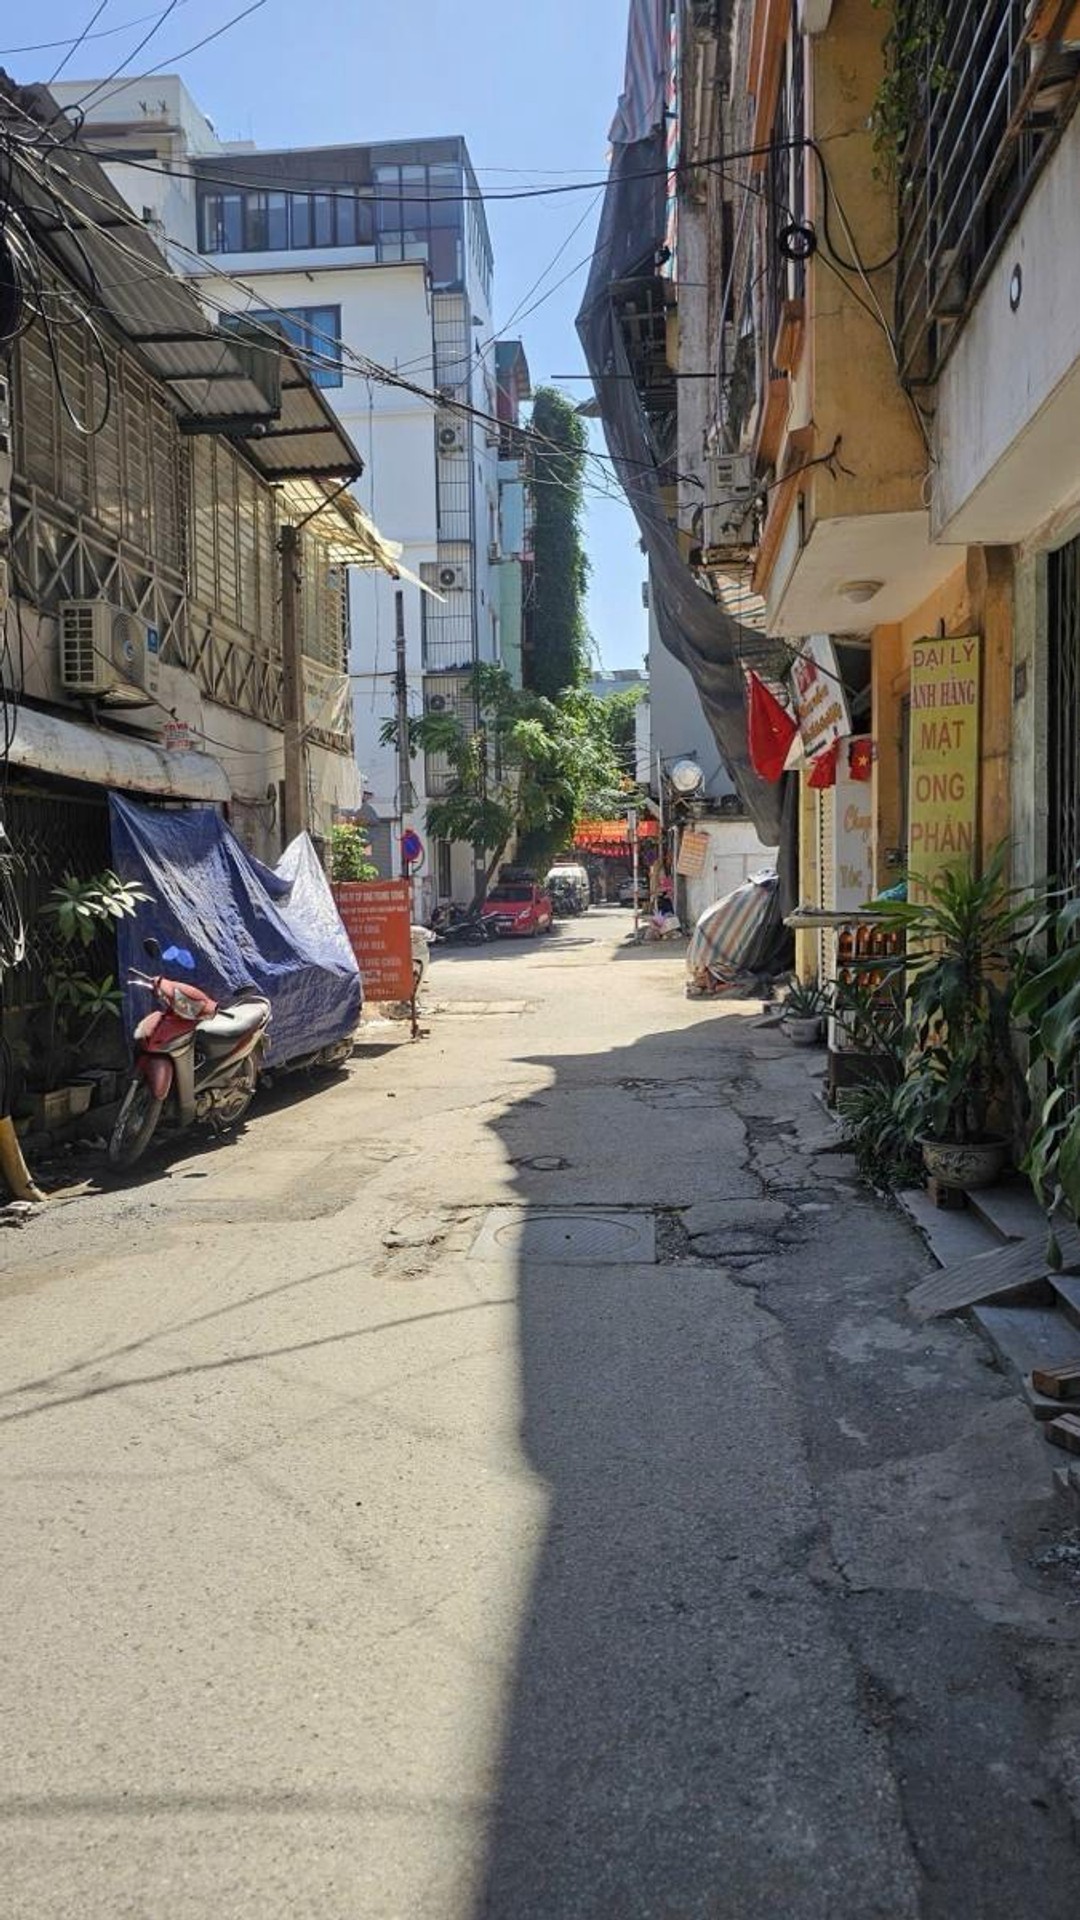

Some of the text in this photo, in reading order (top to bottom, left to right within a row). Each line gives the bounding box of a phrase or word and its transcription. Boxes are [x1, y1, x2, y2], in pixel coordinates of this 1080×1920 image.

[912, 646, 944, 671] ĐẠI
[922, 717, 965, 757] MẬT
[916, 772, 965, 802] ONG
